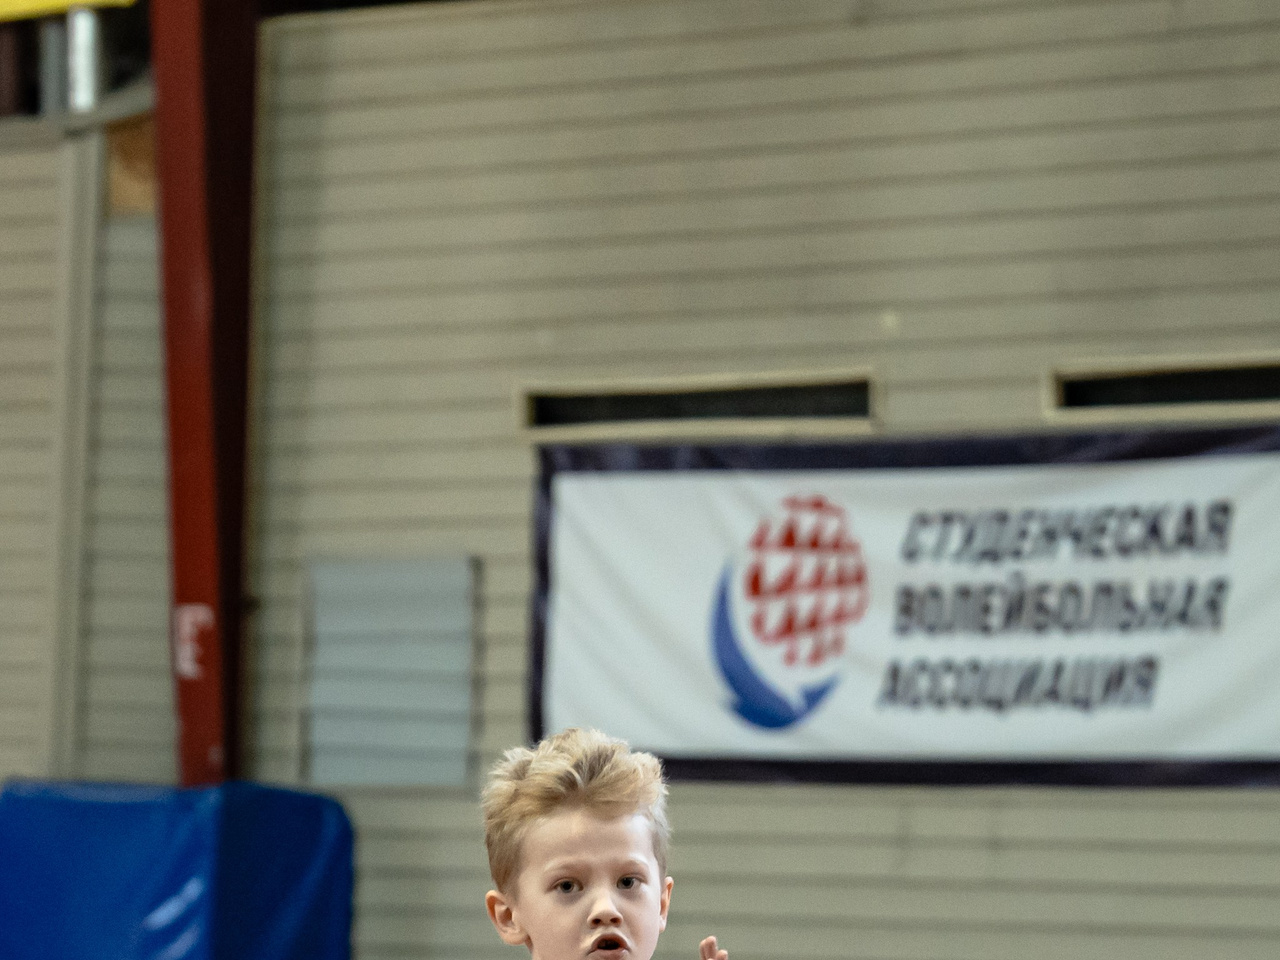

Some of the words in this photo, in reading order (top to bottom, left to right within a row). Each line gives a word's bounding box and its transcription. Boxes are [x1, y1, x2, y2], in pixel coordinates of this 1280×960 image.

[901, 499, 1234, 564] СТУДЕНЧЕСКАЯ
[893, 571, 1230, 636] ВОЛЕЙБОЛЬНАЯ
[876, 656, 1158, 715] АССОЦИАЦИЯ
